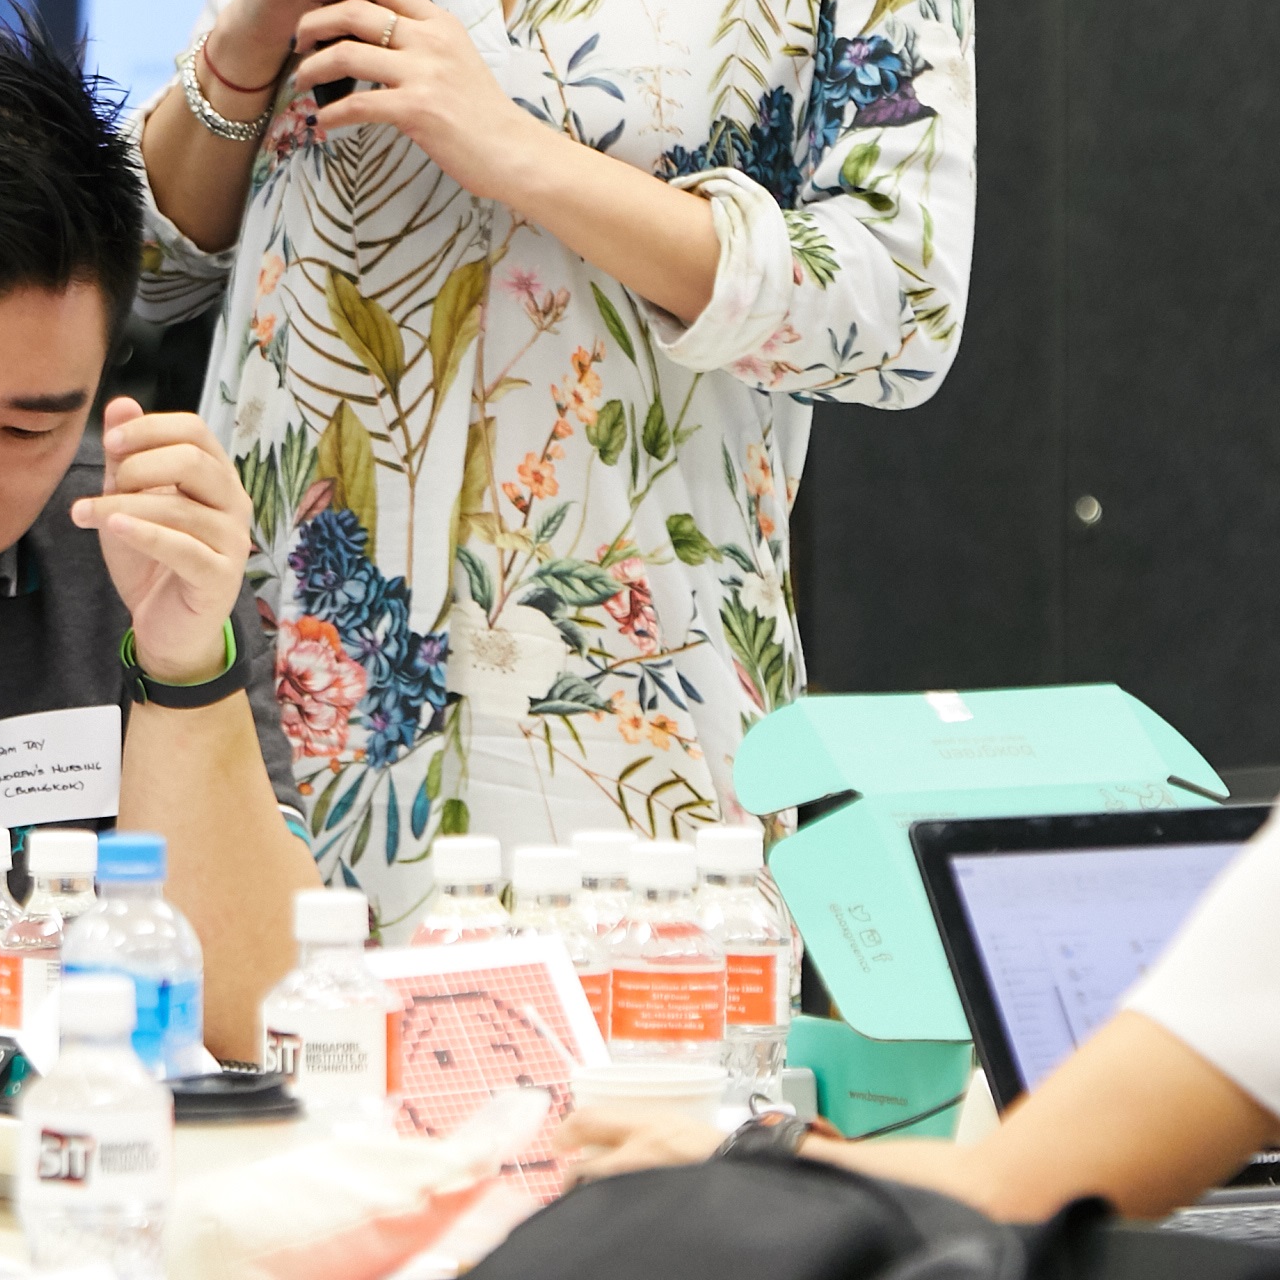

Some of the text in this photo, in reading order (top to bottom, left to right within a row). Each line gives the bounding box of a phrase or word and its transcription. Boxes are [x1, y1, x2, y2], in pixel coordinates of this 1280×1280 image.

[266, 1038, 301, 1075] SIT
[306, 1042, 359, 1053] SINGAPORE
[39, 1136, 92, 1180] SIT
